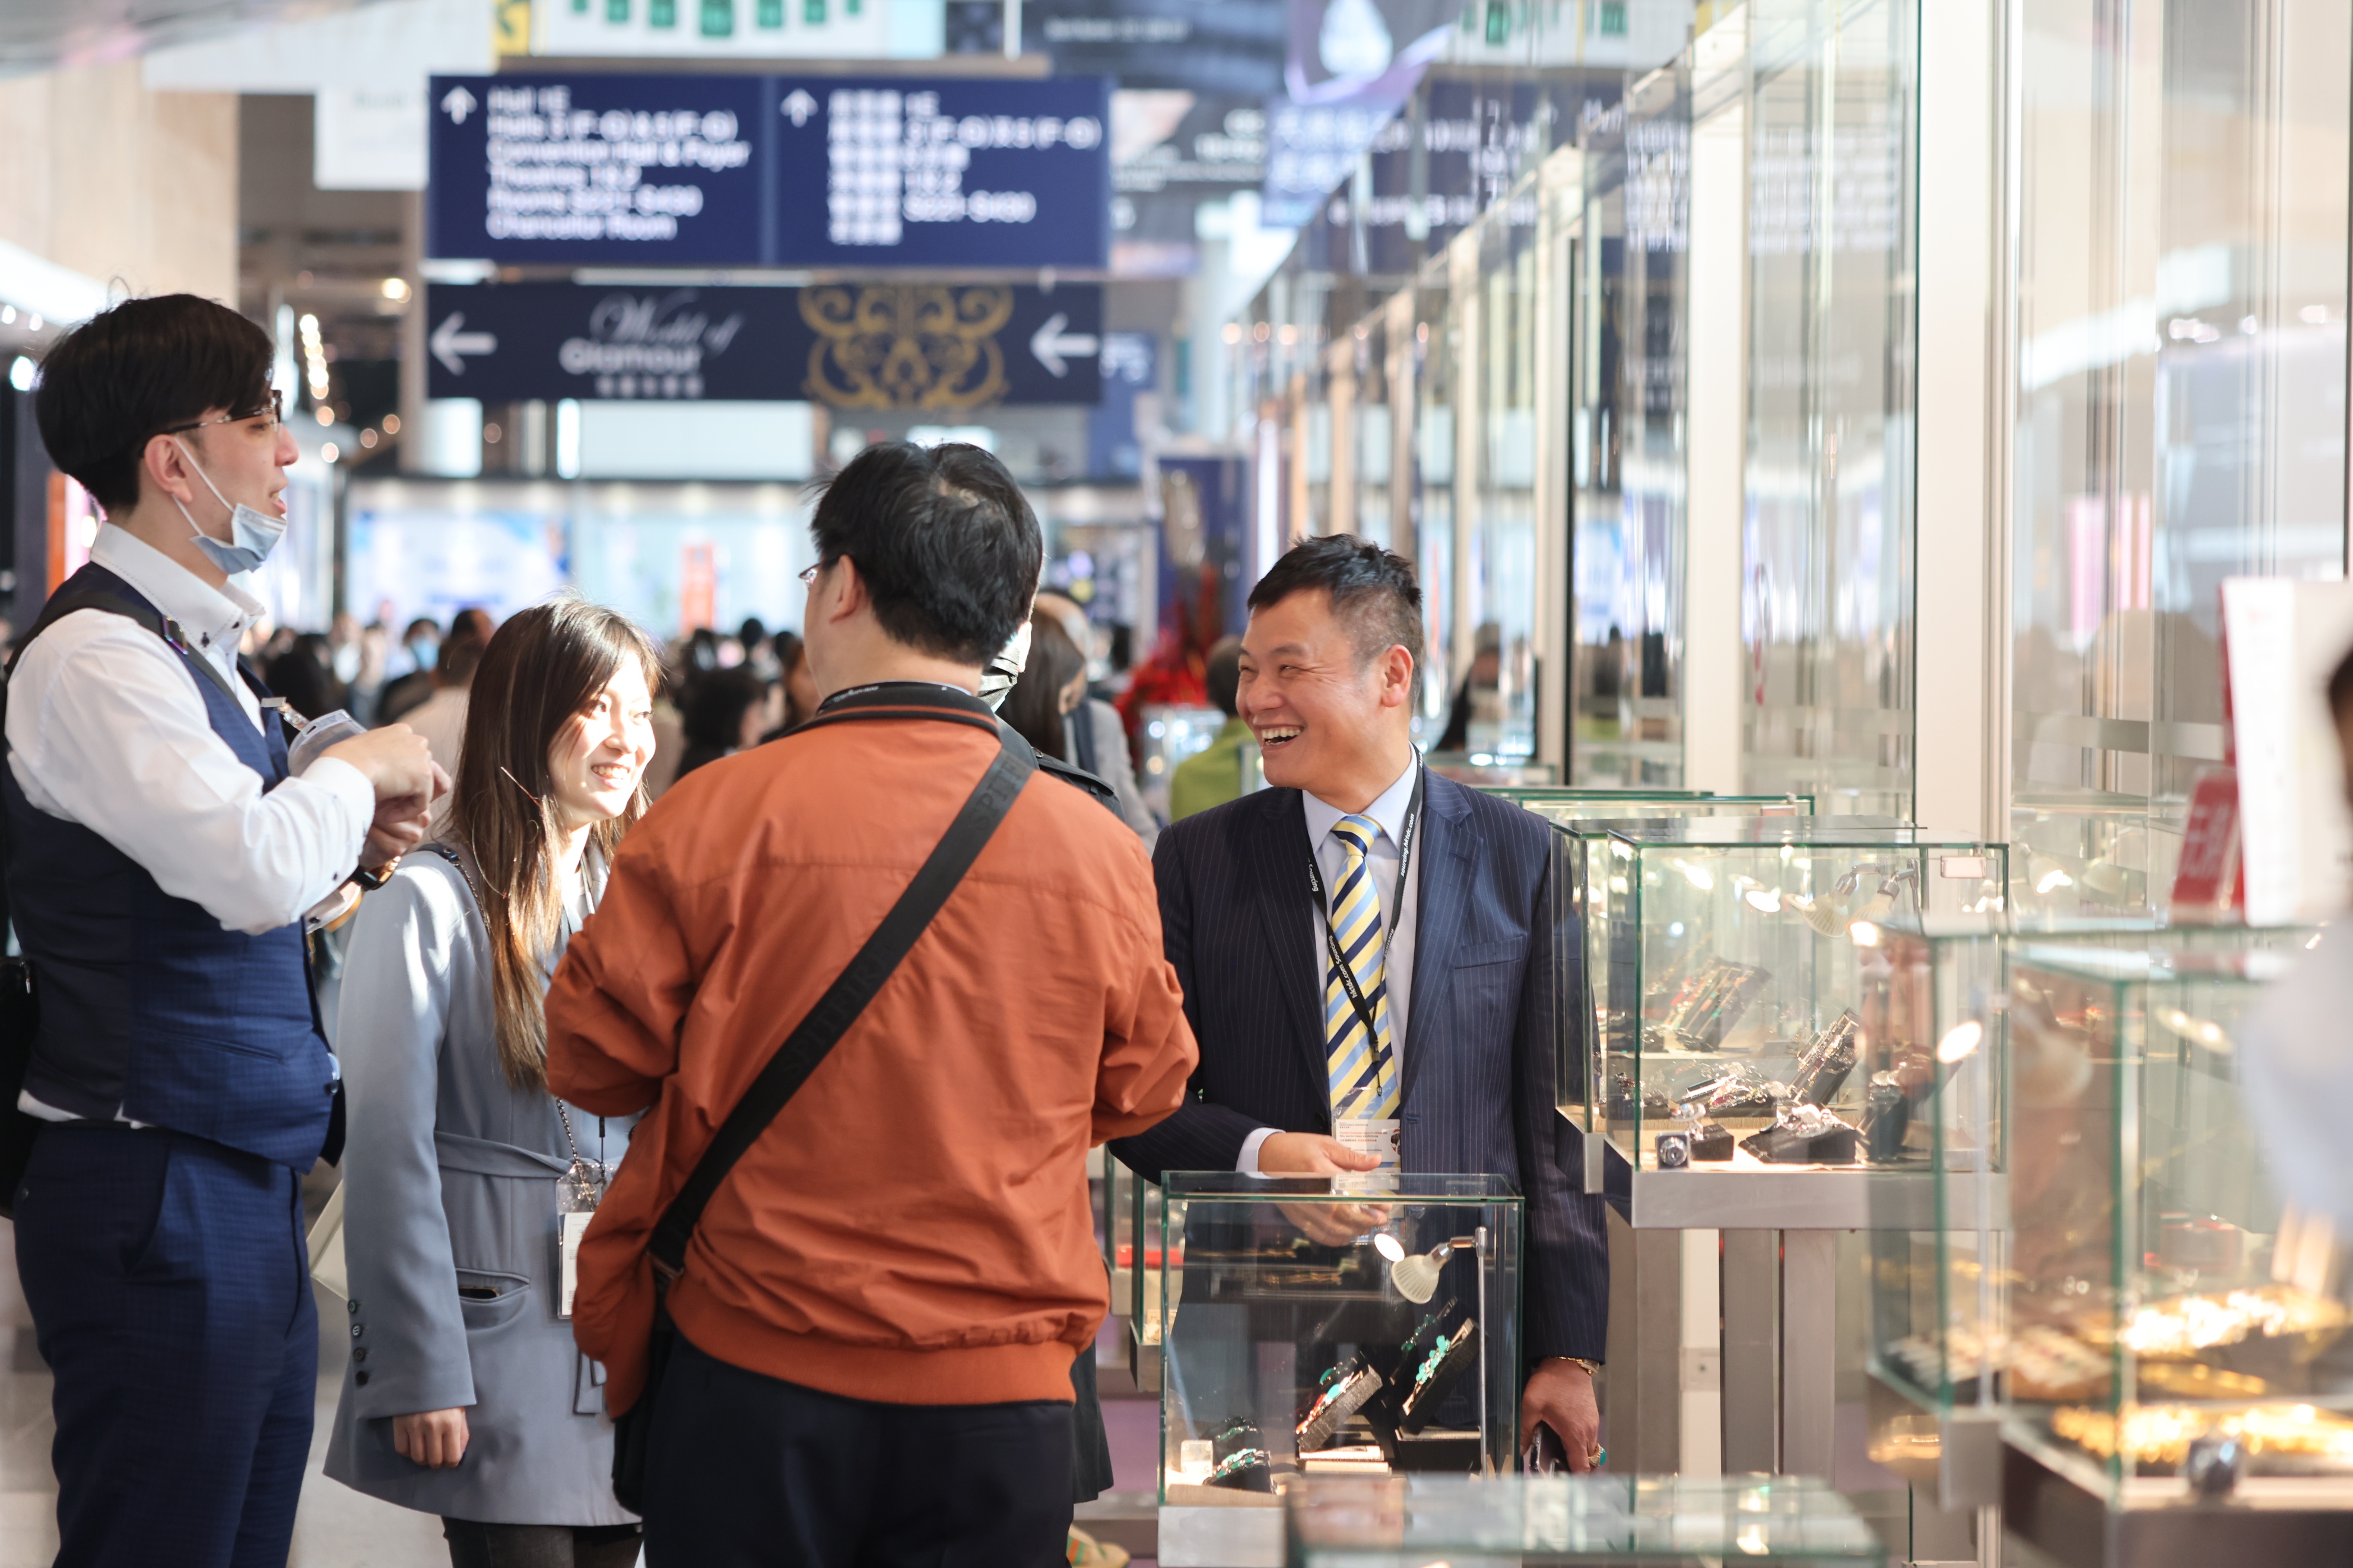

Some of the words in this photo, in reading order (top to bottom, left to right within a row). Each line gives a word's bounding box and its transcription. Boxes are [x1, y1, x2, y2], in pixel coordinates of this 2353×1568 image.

[560, 341, 701, 374] Glamour
[1401, 813, 1414, 877] sourcing.hktdc.com
[1329, 935, 1341, 965] Sourcing
[1339, 963, 1358, 998] hktdc.com
